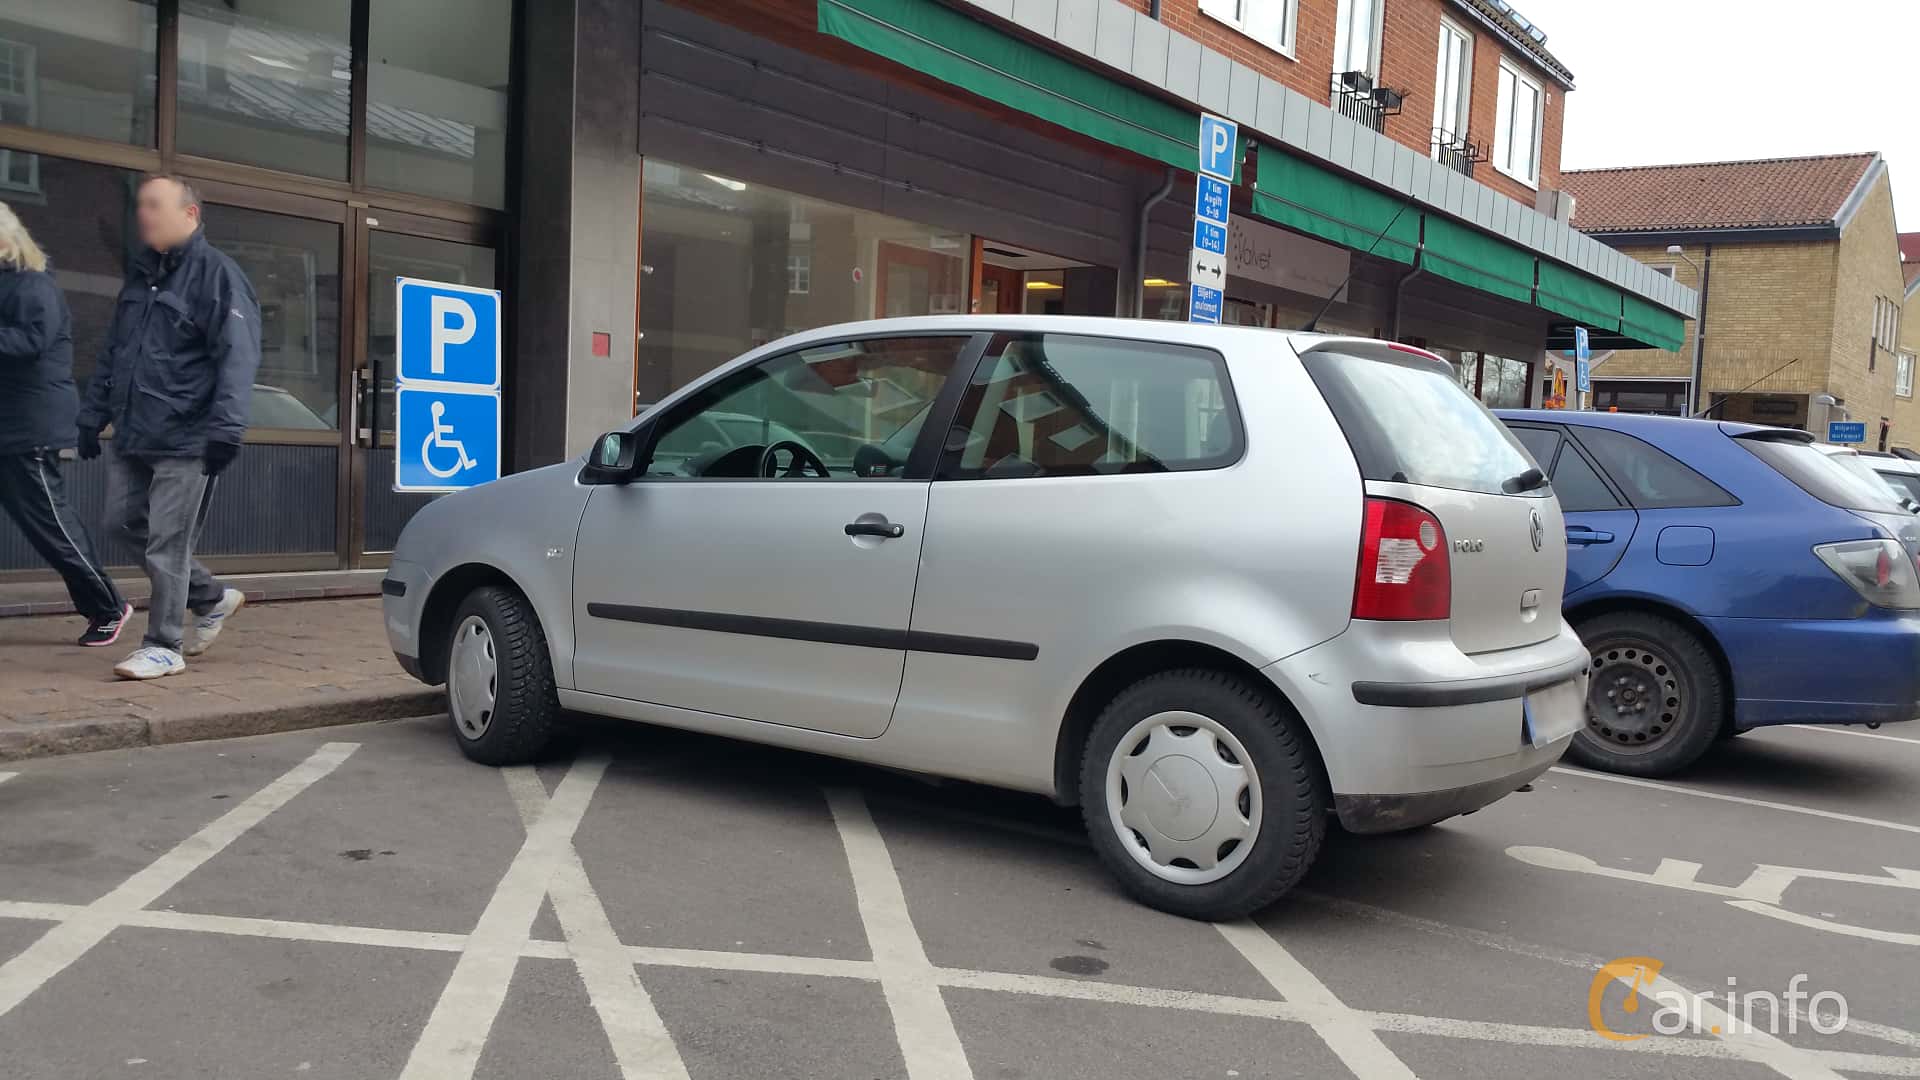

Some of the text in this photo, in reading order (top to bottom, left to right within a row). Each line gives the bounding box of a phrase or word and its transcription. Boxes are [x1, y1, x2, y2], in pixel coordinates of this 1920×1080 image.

[1211, 124, 1228, 168] P
[1210, 227, 1219, 238] tim
[1202, 238, 1220, 250] (9-14)
[431, 295, 477, 374] P
[1453, 539, 1484, 553] POLO
